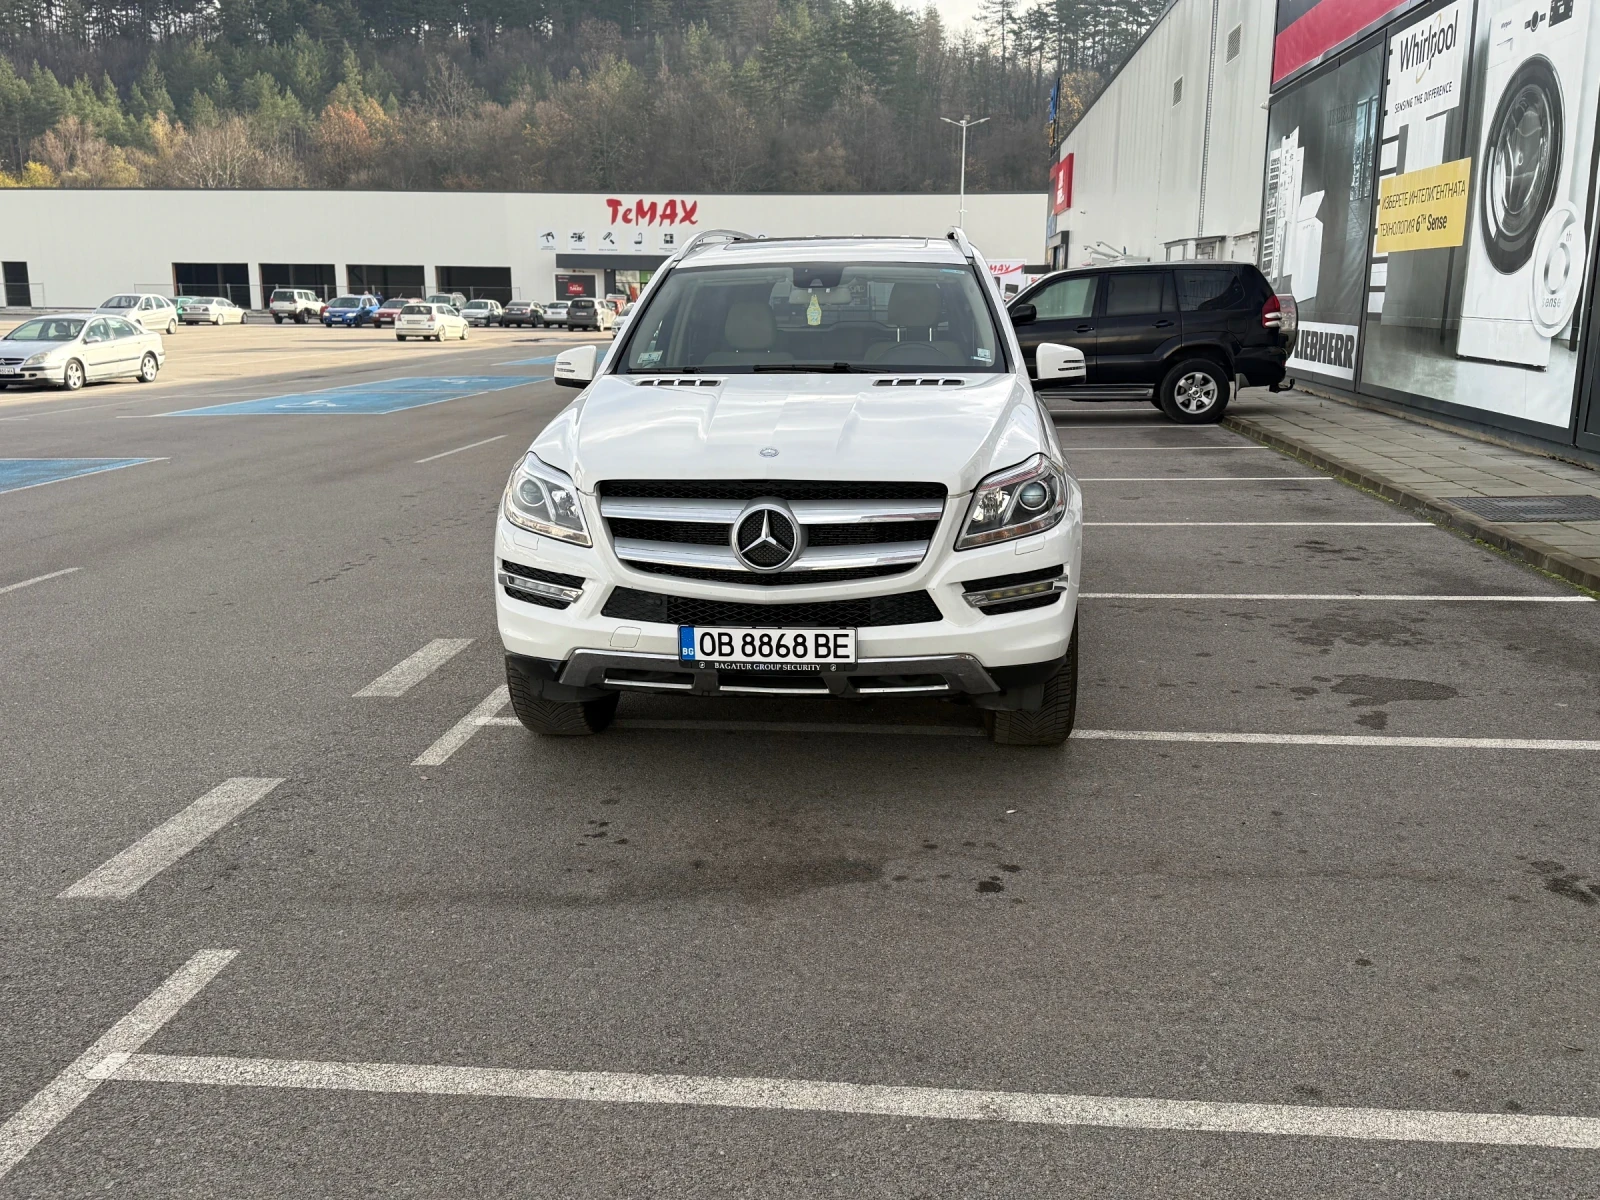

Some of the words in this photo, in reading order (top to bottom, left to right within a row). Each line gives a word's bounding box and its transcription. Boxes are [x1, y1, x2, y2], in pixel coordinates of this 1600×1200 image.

[1400, 9, 1459, 72] Whirlpool
[1394, 97, 1414, 114] SENSING
[1414, 93, 1423, 105] THE
[1423, 81, 1453, 103] DIFFERENCE
[1381, 191, 1409, 210] ИЗБЕРЕТЕ
[1408, 180, 1466, 205] ИНТЕЛИГЕНТНАТА
[1380, 218, 1415, 237] ТЕХНОЛОГИЯ
[1426, 213, 1448, 232] Sense
[1293, 329, 1355, 370] LIEBHERR
[682, 647, 694, 656] BG
[699, 631, 735, 657] OB
[741, 632, 808, 658] 8868
[814, 633, 850, 659] BE
[714, 662, 752, 670] BAGATUR
[753, 663, 782, 671] GROUP
[782, 663, 821, 672] SECURITY
